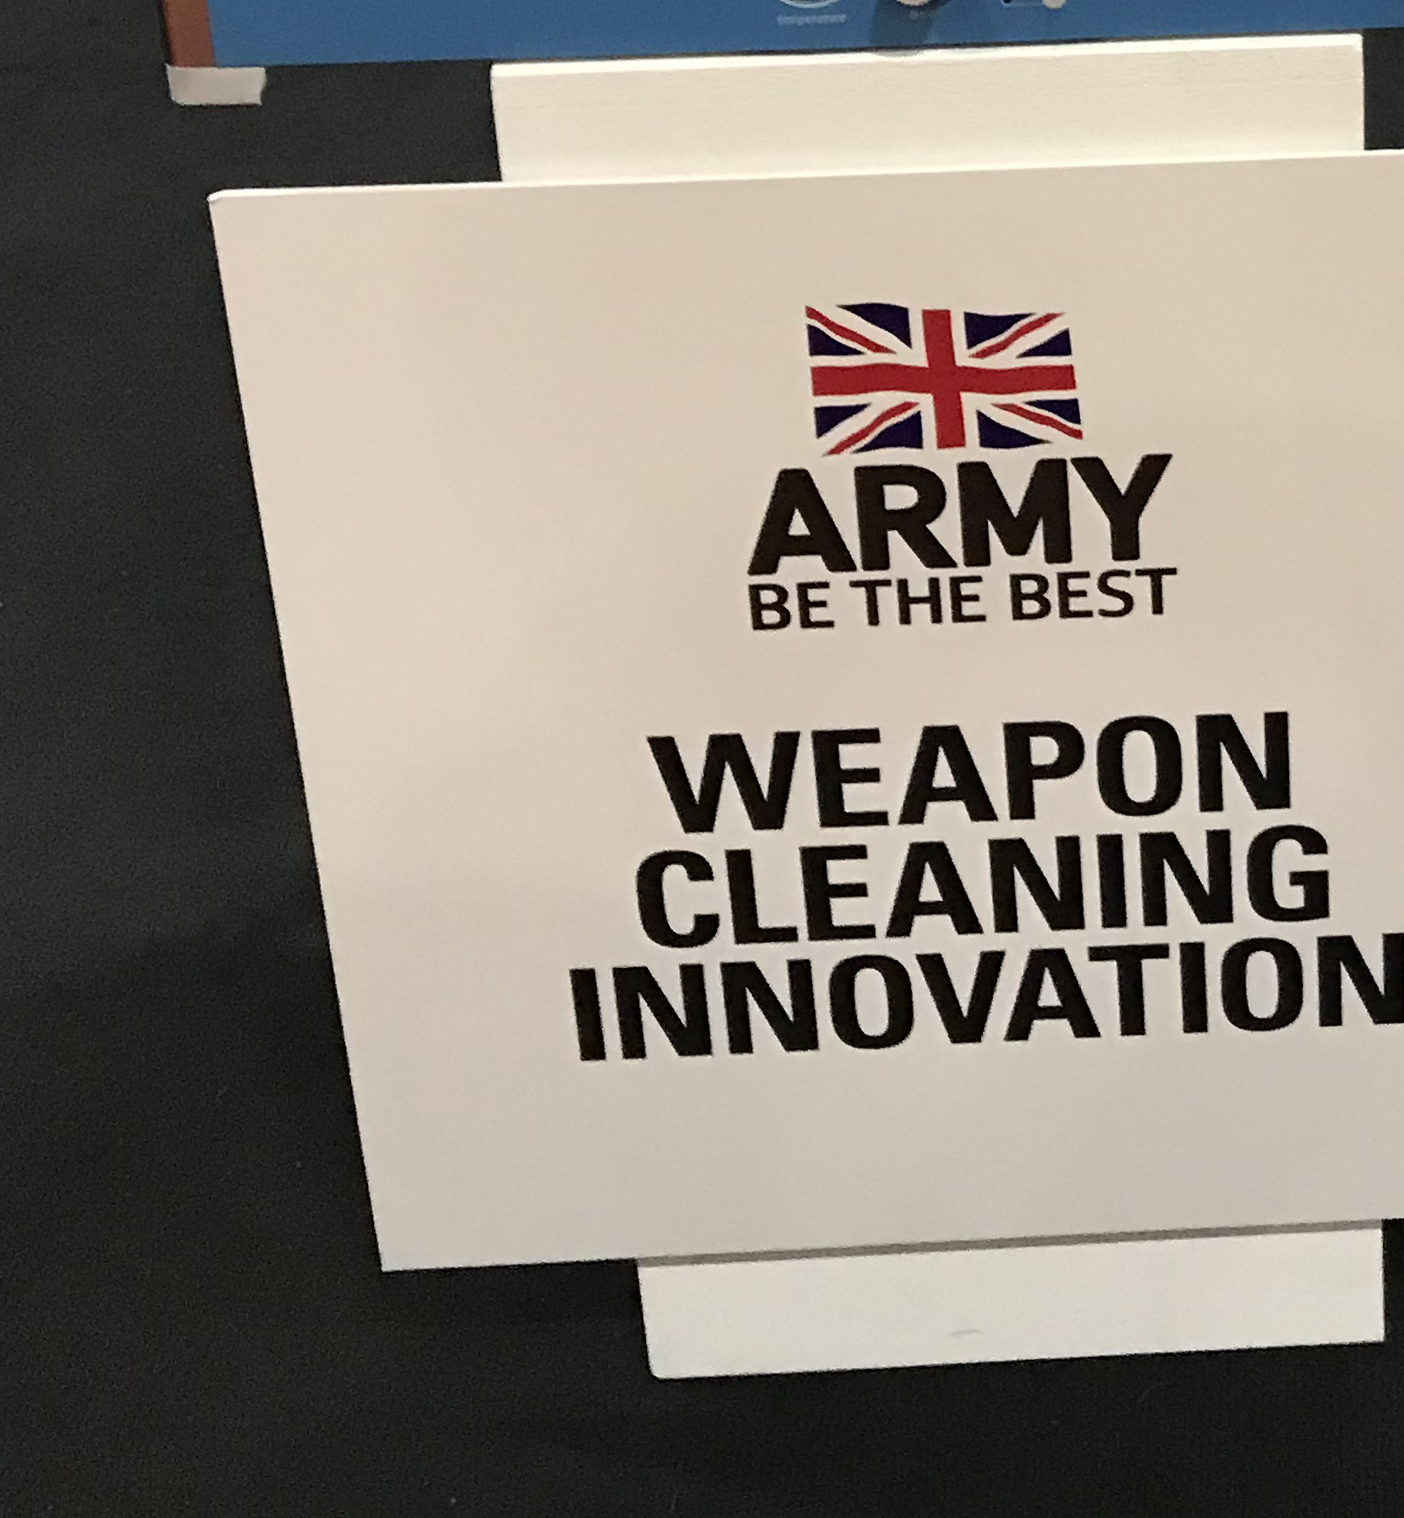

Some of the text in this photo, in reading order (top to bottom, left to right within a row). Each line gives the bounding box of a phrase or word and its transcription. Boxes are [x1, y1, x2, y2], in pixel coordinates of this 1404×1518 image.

[747, 453, 1173, 576] ARMY
[748, 567, 1178, 630] BE THE BEST
[646, 711, 1293, 833] WEAPON
[635, 825, 1330, 948] CLEANING
